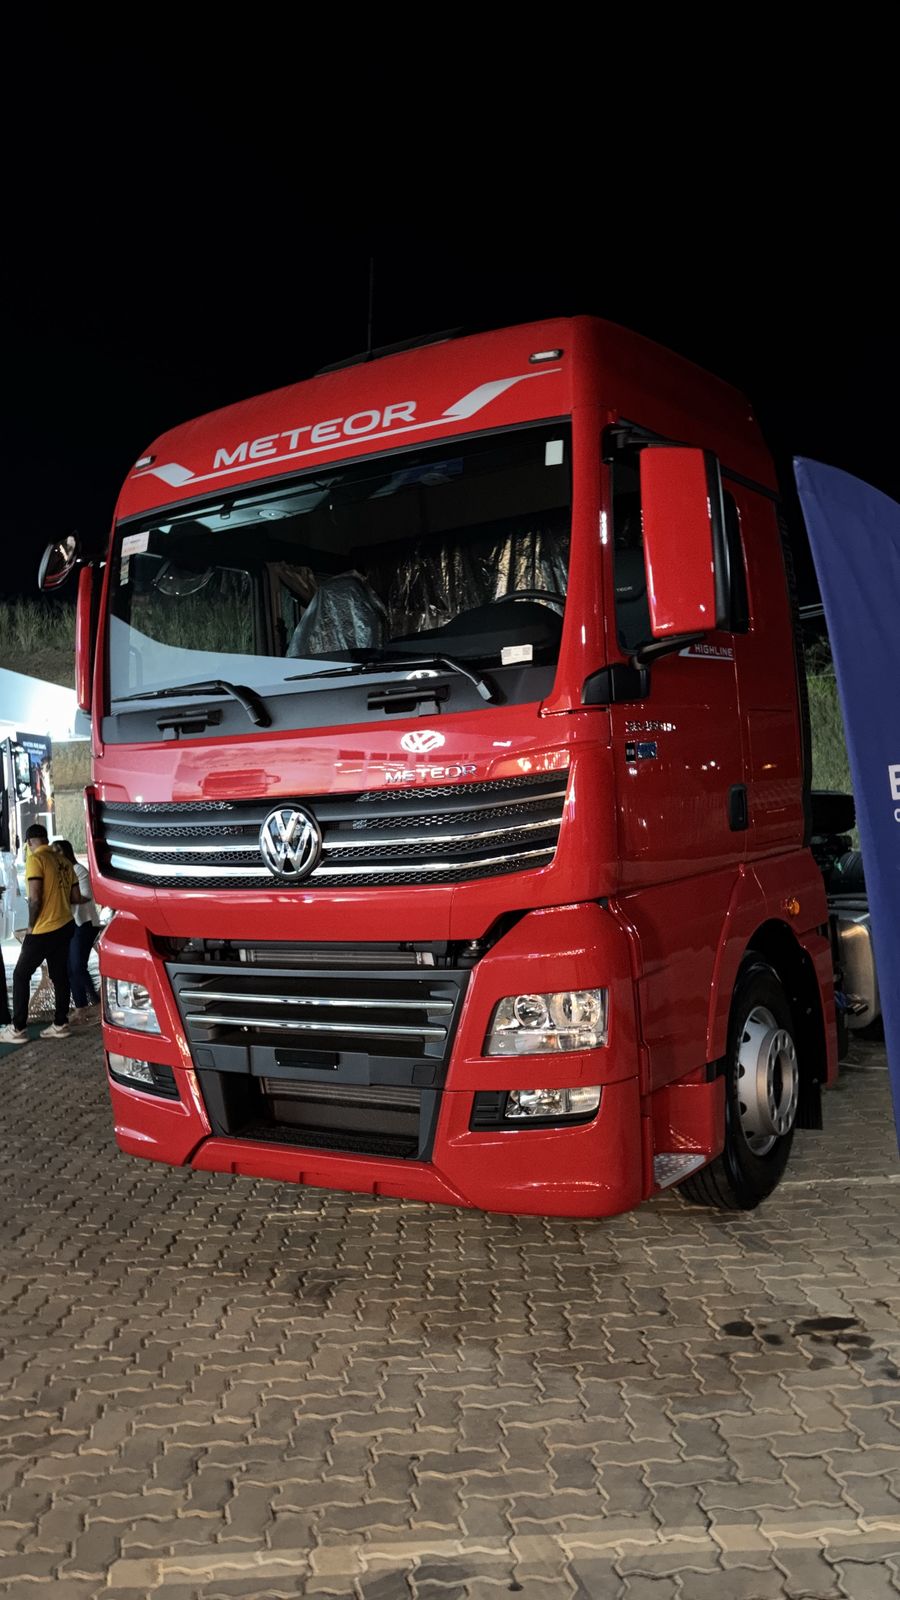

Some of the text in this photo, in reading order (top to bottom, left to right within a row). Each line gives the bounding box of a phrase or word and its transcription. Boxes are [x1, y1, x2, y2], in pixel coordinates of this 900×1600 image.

[212, 400, 418, 469] METEOR
[694, 643, 734, 657] HIGHLINE
[384, 764, 478, 783] METEOR
